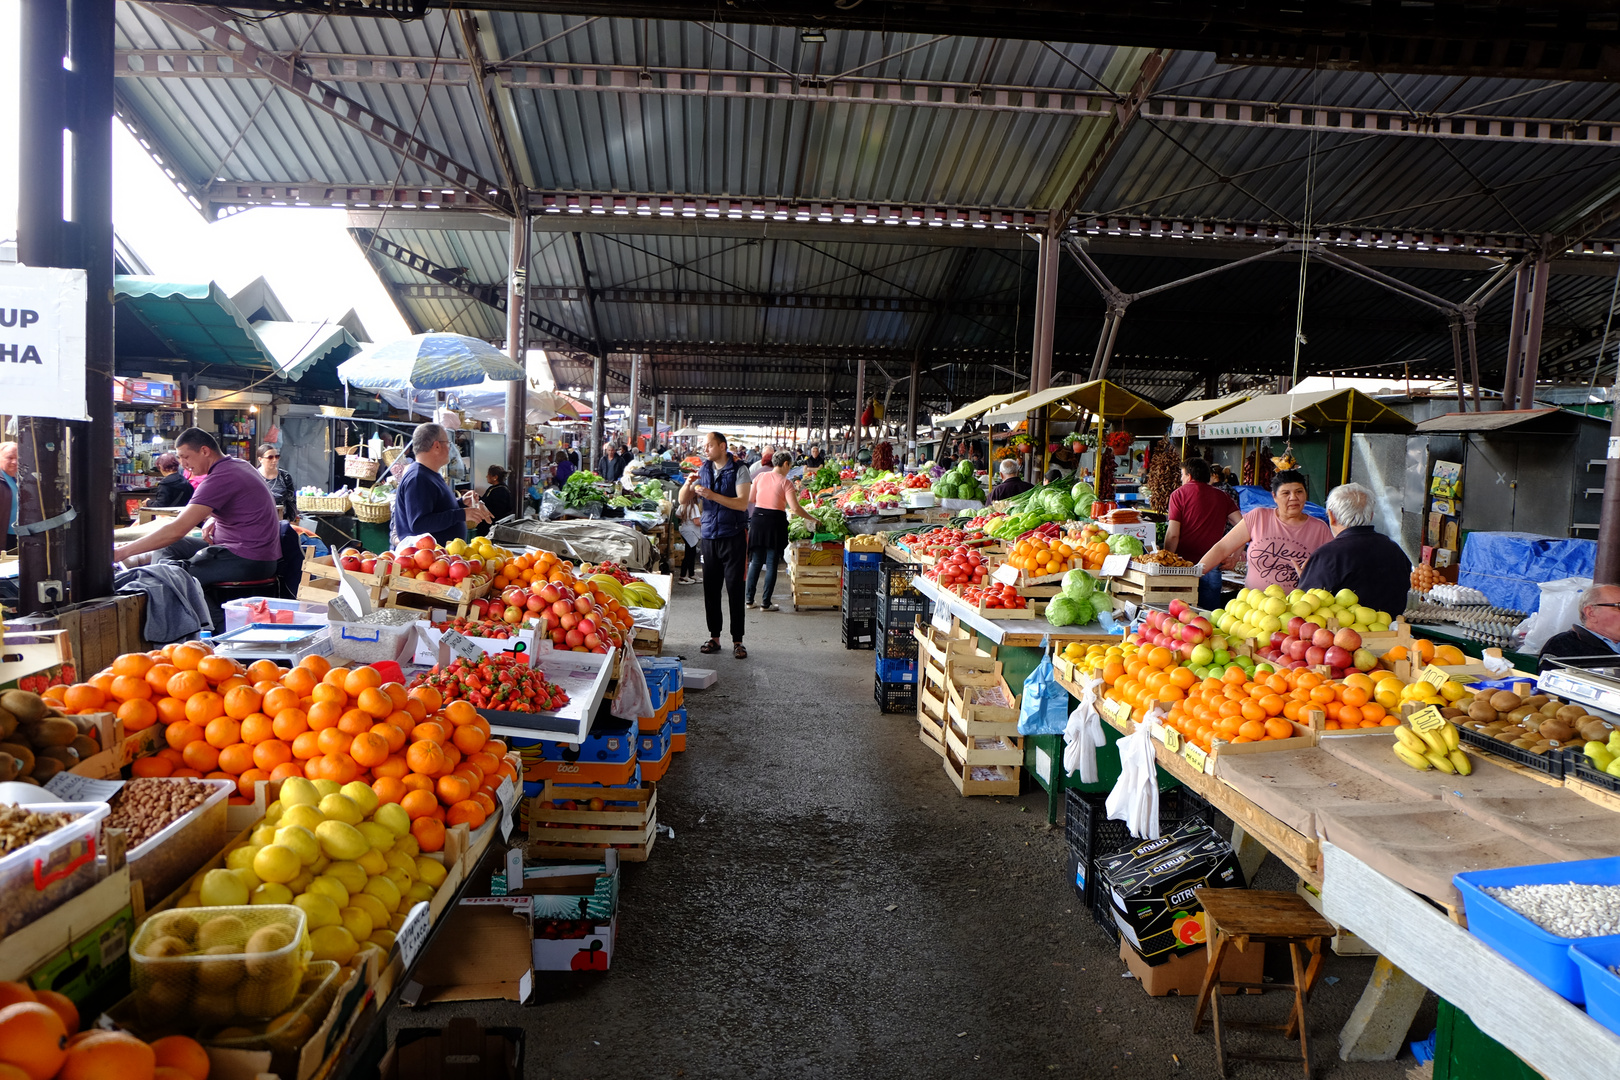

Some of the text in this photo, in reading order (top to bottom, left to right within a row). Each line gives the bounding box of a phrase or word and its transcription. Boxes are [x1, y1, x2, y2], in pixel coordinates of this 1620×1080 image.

[0, 308, 39, 328] UP
[1209, 424, 1263, 436] NAŠA BAŠTA
[1250, 542, 1308, 561] New
[1414, 710, 1441, 730] 130
[557, 763, 580, 773] toco
[1137, 838, 1169, 855] CITRUS
[1153, 855, 1186, 873] CITRUS
